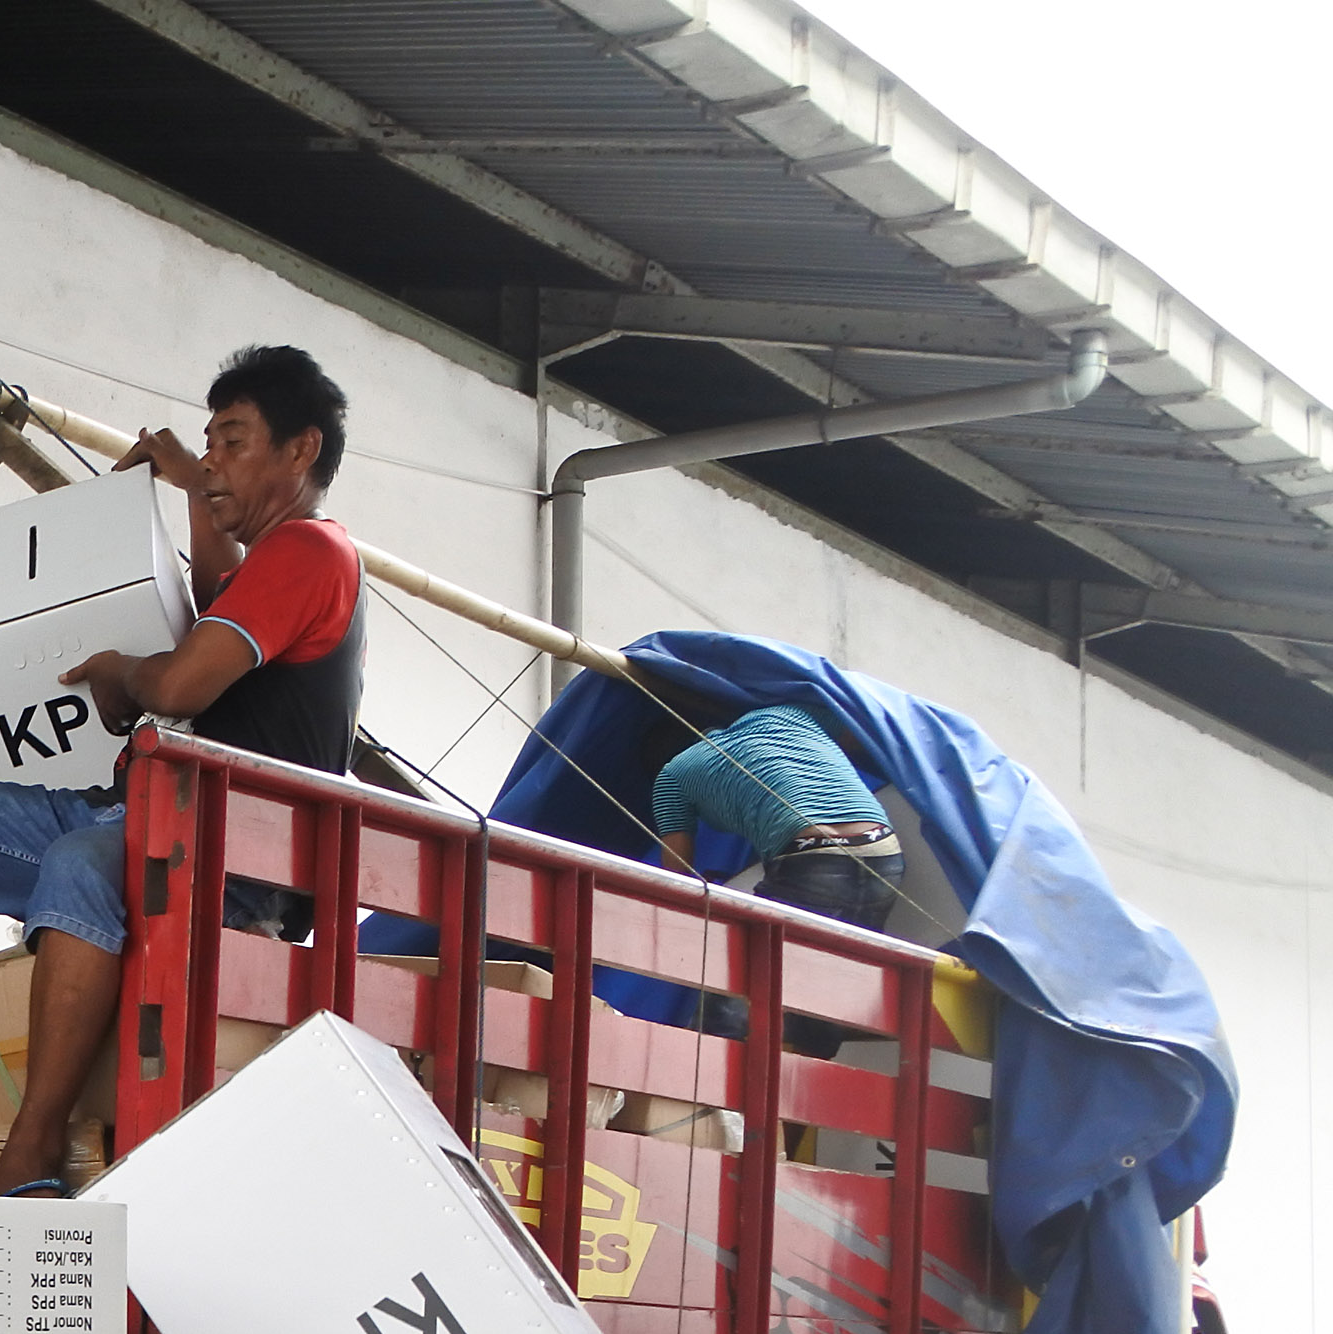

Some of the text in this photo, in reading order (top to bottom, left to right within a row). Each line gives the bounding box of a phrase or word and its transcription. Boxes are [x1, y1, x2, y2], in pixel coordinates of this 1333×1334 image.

[44, 1230, 92, 1245] Provinsi
[36, 1251, 92, 1267] Kab./Kota
[31, 1273, 92, 1288] Nama PPK
[31, 1295, 92, 1310] Nama PPS
[26, 1316, 92, 1332] Nomor TPS
